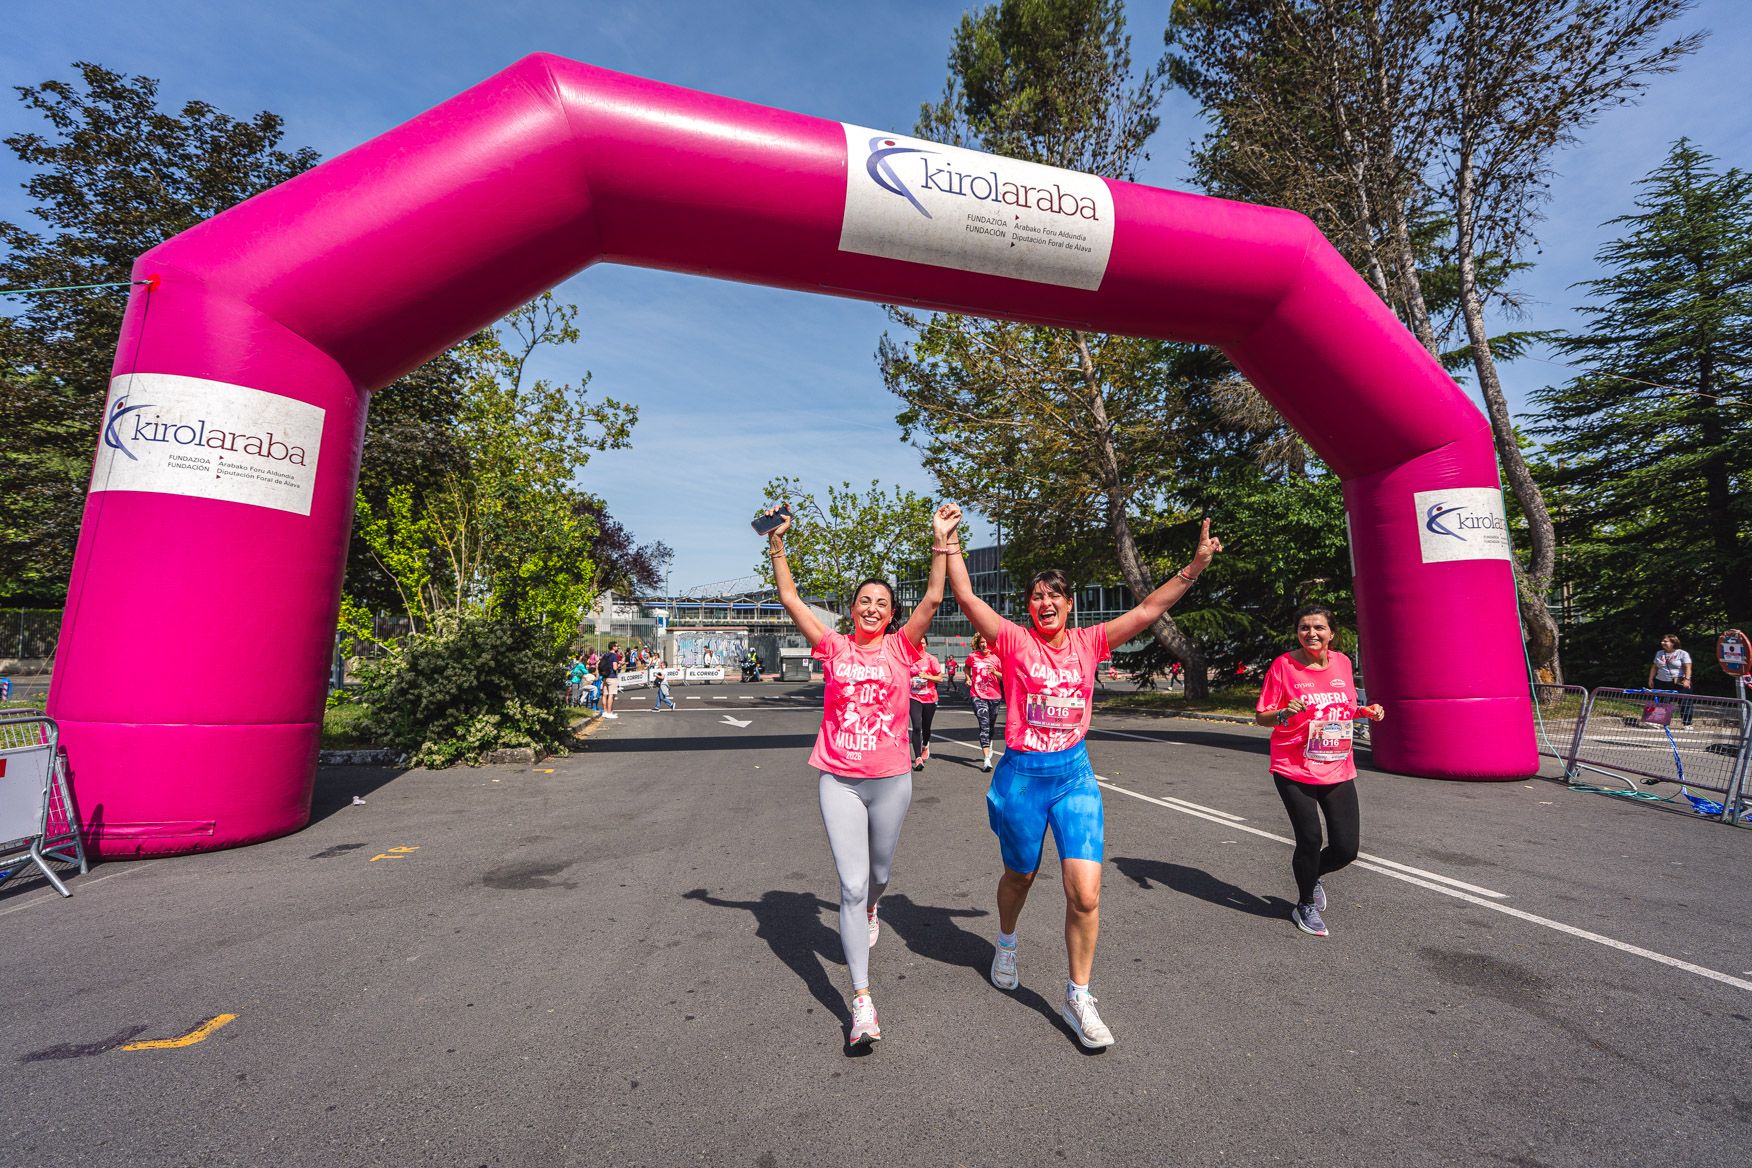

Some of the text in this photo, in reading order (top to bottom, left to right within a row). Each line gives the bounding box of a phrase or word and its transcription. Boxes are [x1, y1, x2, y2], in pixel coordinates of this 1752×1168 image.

[920, 157, 1099, 221] kirolaraba
[967, 213, 1008, 228] FUNDAZIOA
[1012, 232, 1047, 246] Diputación
[1048, 239, 1064, 248] Foral
[1014, 222, 1087, 242] Arabako Foru Aldundia
[131, 414, 307, 467] kirolaraba
[168, 454, 211, 465] FUNDAZIOA
[216, 468, 255, 480] Diputación
[256, 474, 274, 483] Foral
[218, 461, 296, 480] Arabako Foru Aldundia
[1457, 512, 1506, 530] kirolar
[1300, 691, 1349, 706] CARRERA
[1047, 706, 1069, 717] 016
[835, 729, 878, 751] MUJER
[1322, 739, 1340, 747] 016
